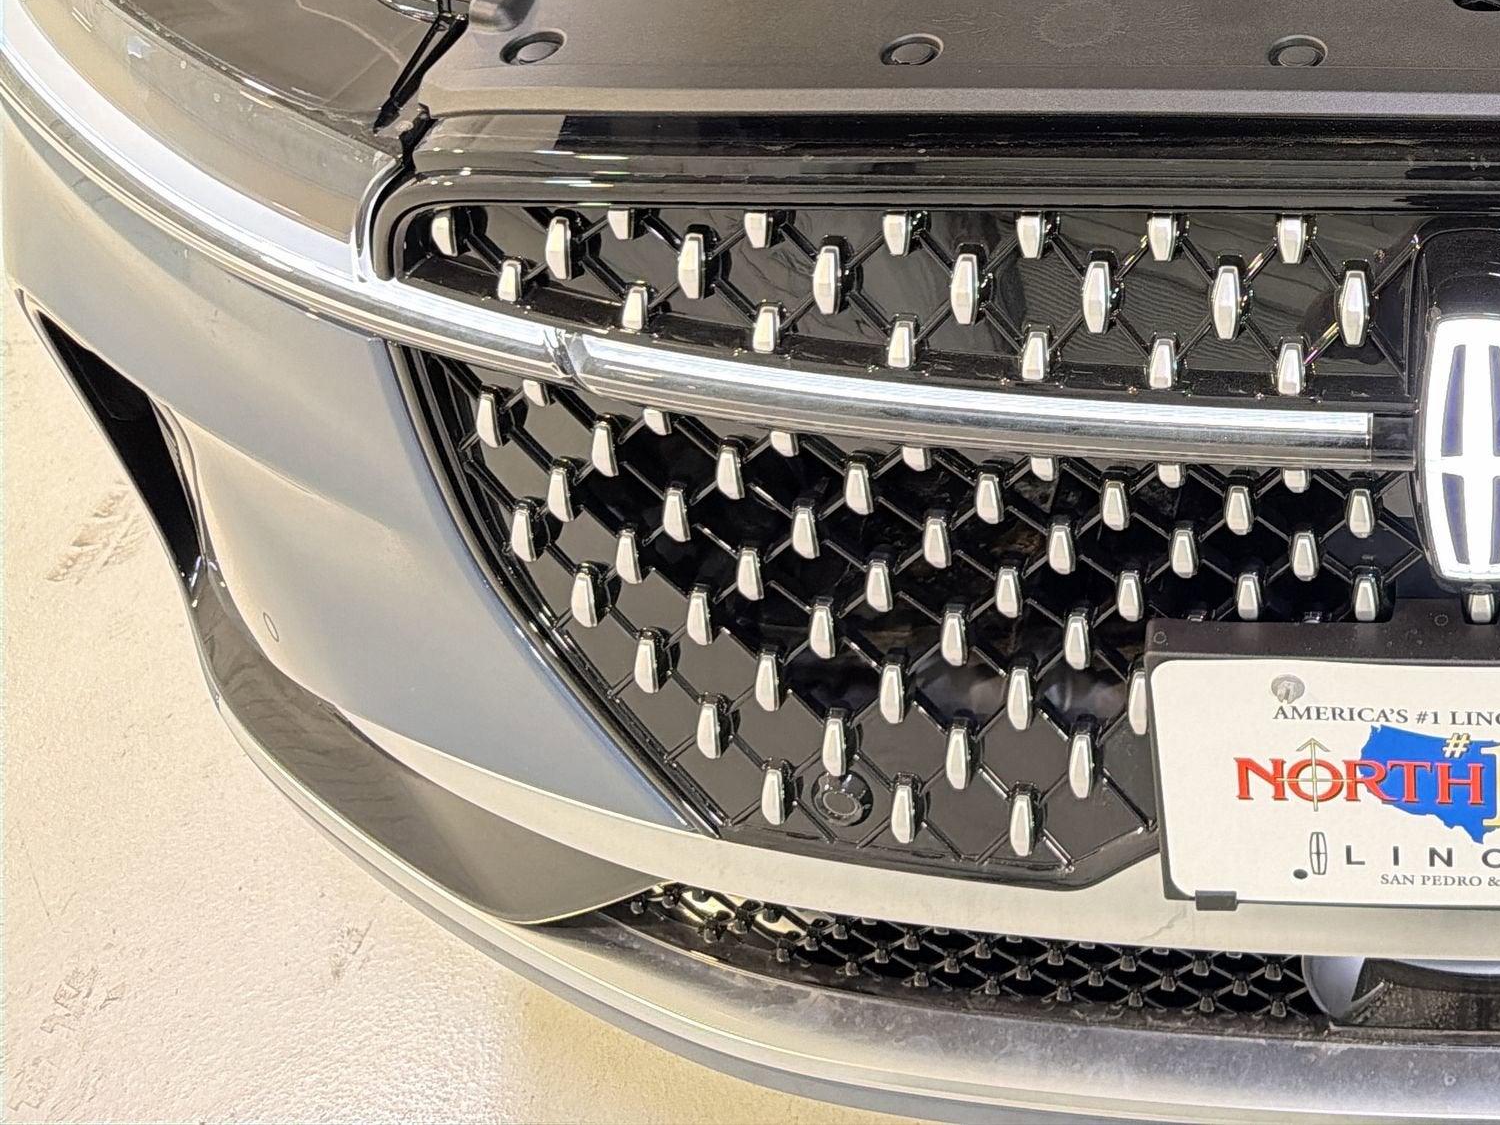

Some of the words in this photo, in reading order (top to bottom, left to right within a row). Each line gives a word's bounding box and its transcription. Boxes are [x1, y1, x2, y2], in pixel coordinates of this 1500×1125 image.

[1273, 705, 1409, 725] AMERICA'S
[1416, 711, 1441, 725] #1
[1234, 757, 1485, 806] NORTH
[1380, 874, 1414, 887] SAN
[1422, 875, 1482, 887] PEDRO
[1487, 875, 1500, 887] &
